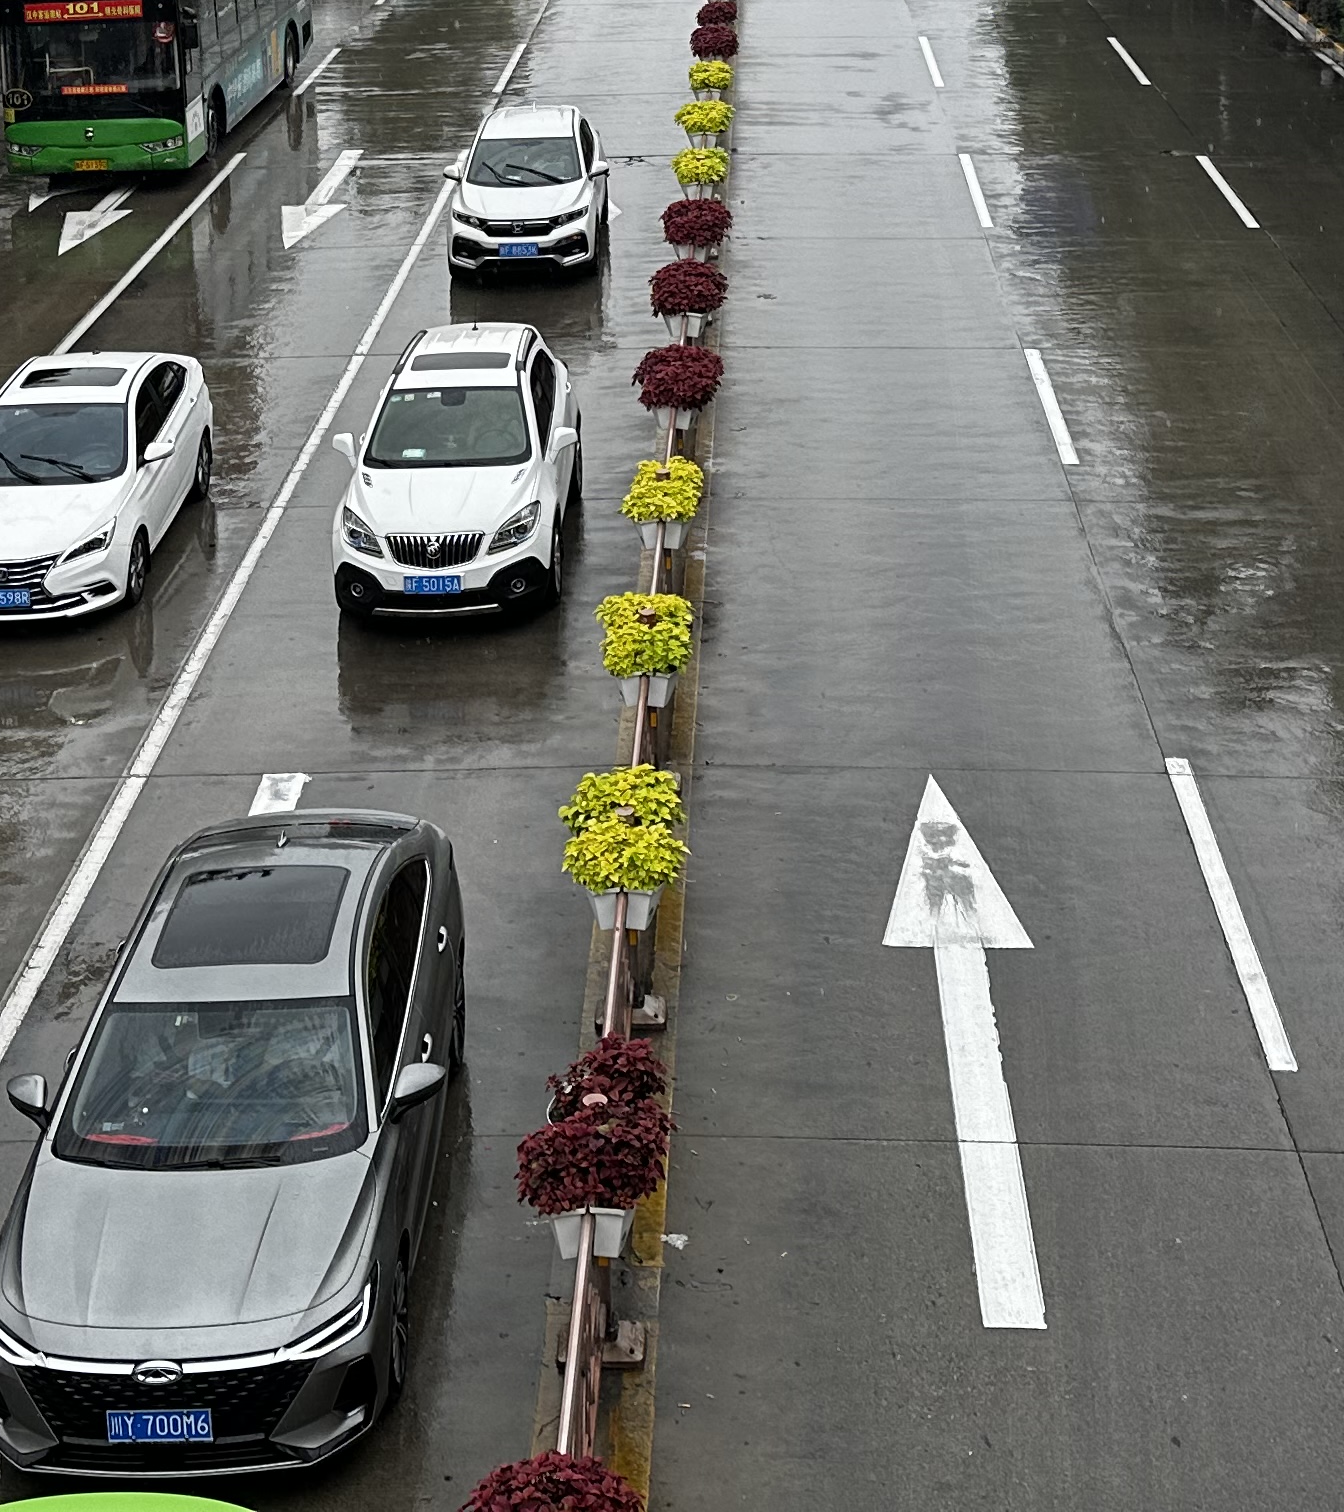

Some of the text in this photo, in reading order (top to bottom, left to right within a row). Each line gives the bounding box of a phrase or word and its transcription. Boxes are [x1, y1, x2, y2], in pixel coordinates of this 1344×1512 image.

[65, 2, 99, 14] 101
[8, 93, 28, 105] 101
[111, 1414, 209, 1436] 川Y·700M6
